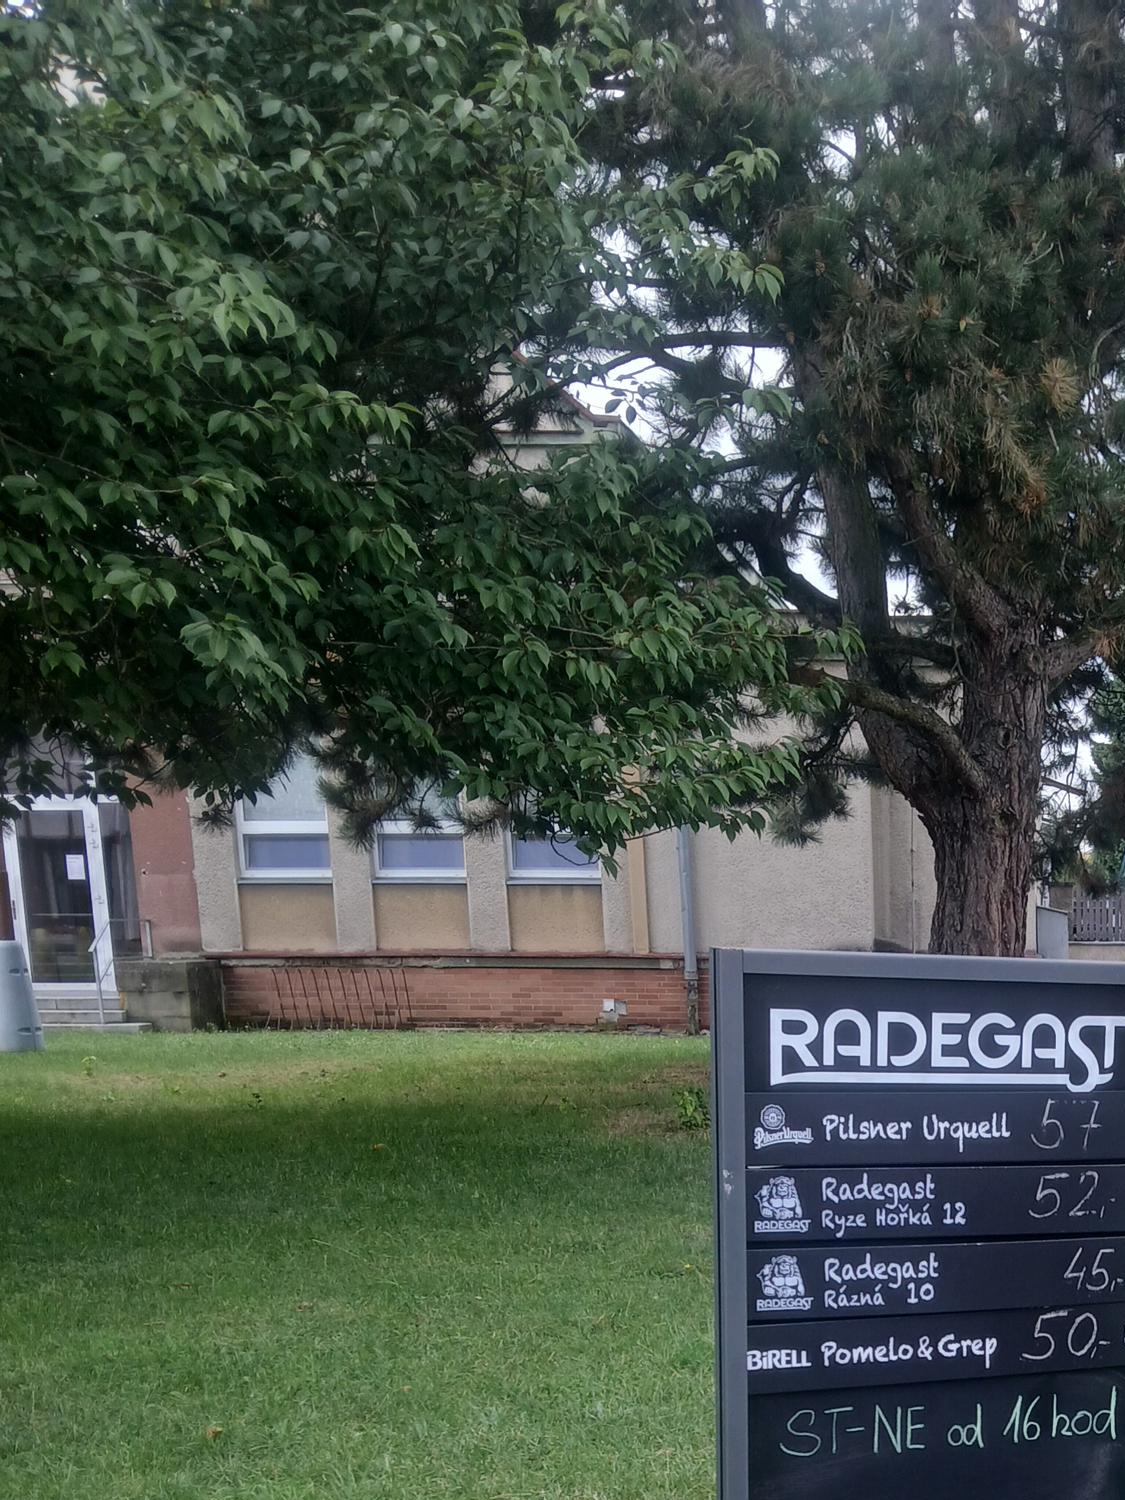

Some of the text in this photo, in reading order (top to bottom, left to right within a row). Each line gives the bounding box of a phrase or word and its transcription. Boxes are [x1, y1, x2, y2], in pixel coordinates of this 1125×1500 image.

[754, 1125, 814, 1150] Pilsner Urquell
[822, 1112, 913, 1142] Pilsner
[923, 1111, 1011, 1153] Urquell
[1030, 1098, 1102, 1151] 57
[821, 1172, 936, 1209] Radegast
[754, 1219, 812, 1234] RADEGAST
[821, 1201, 967, 1238] Ryze Hořká 12
[823, 1252, 940, 1289] Radegast
[756, 1296, 814, 1312] RADEGAST
[824, 1281, 936, 1310] Rázná 10
[779, 1385, 1117, 1457] ST-NE od 16 hod
